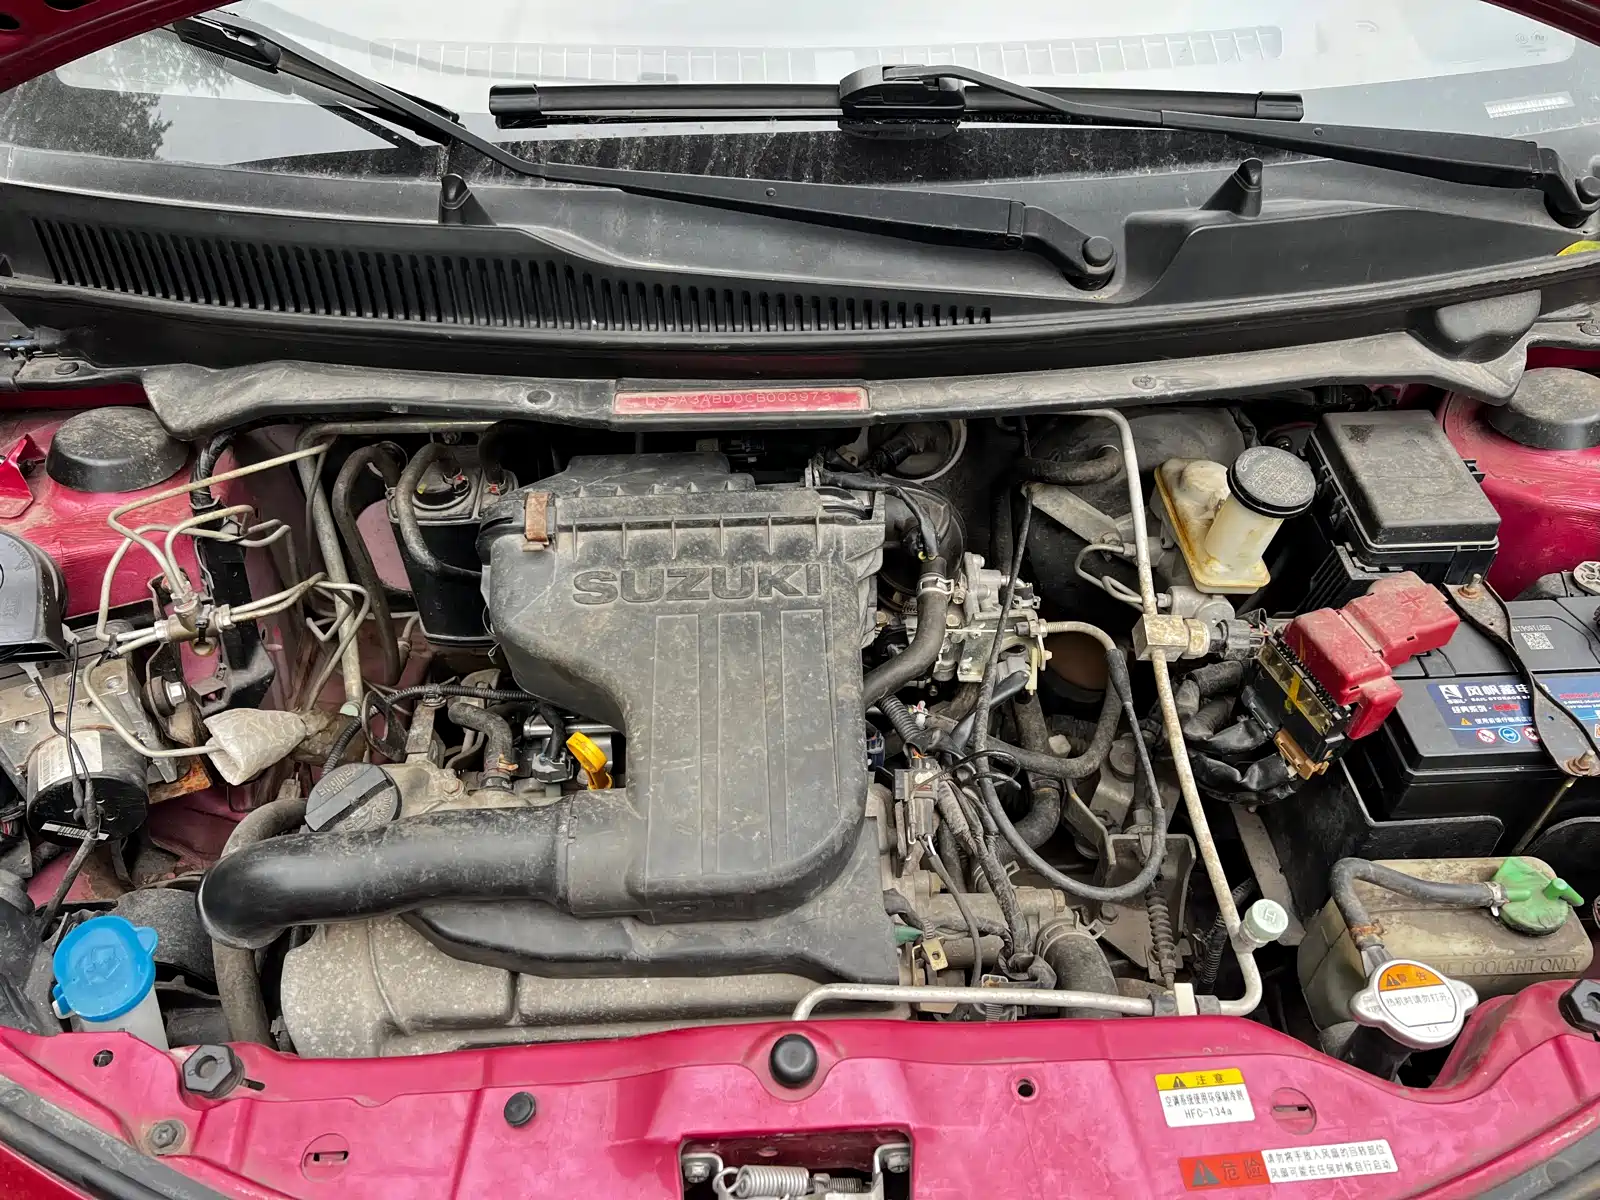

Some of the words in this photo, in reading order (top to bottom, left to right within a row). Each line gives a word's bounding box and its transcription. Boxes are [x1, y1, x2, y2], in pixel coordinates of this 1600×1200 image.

[572, 563, 822, 606] SUZUKI
[316, 767, 354, 797] ENGINE
[1264, 908, 1277, 923] H
[1460, 959, 1535, 974] COOLANT
[1540, 957, 1581, 973] ONLY
[1196, 1073, 1225, 1085] 注意
[1184, 1106, 1233, 1119] HFC-134a
[1220, 1159, 1263, 1181] 危险
